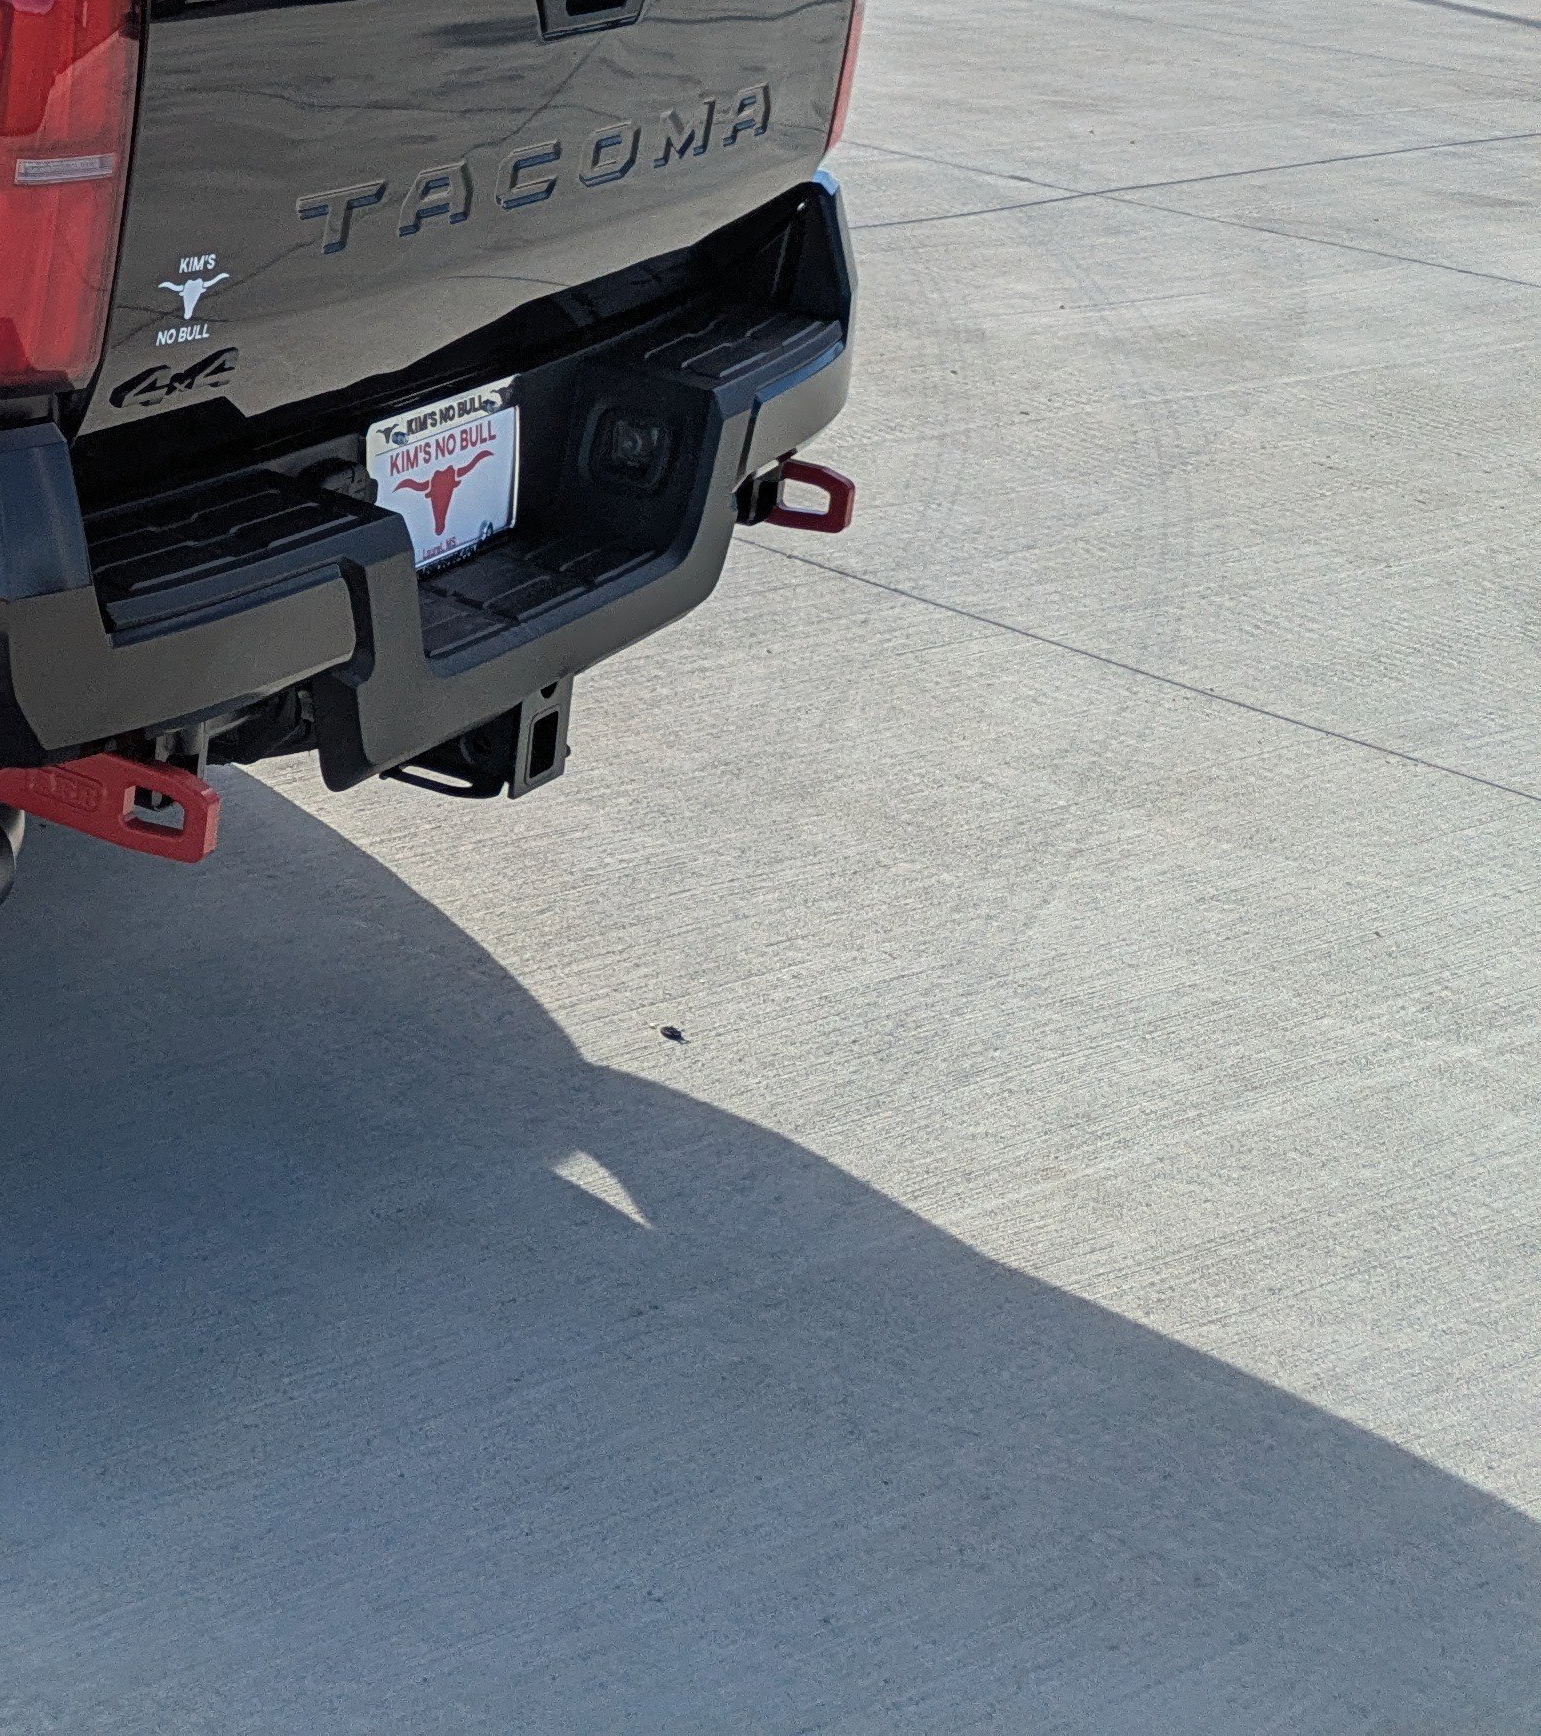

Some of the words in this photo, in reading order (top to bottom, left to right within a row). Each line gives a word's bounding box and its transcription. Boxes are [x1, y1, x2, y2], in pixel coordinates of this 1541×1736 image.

[296, 82, 772, 255] TACOMA
[179, 254, 217, 273] KIM'S
[155, 328, 176, 346] NO
[178, 324, 210, 343] BULL
[406, 410, 438, 435] KIM'S
[439, 404, 456, 425] NO
[457, 394, 484, 418] BULL
[389, 441, 432, 477] KIM'S
[435, 433, 457, 461] NO
[459, 420, 497, 451] BULL
